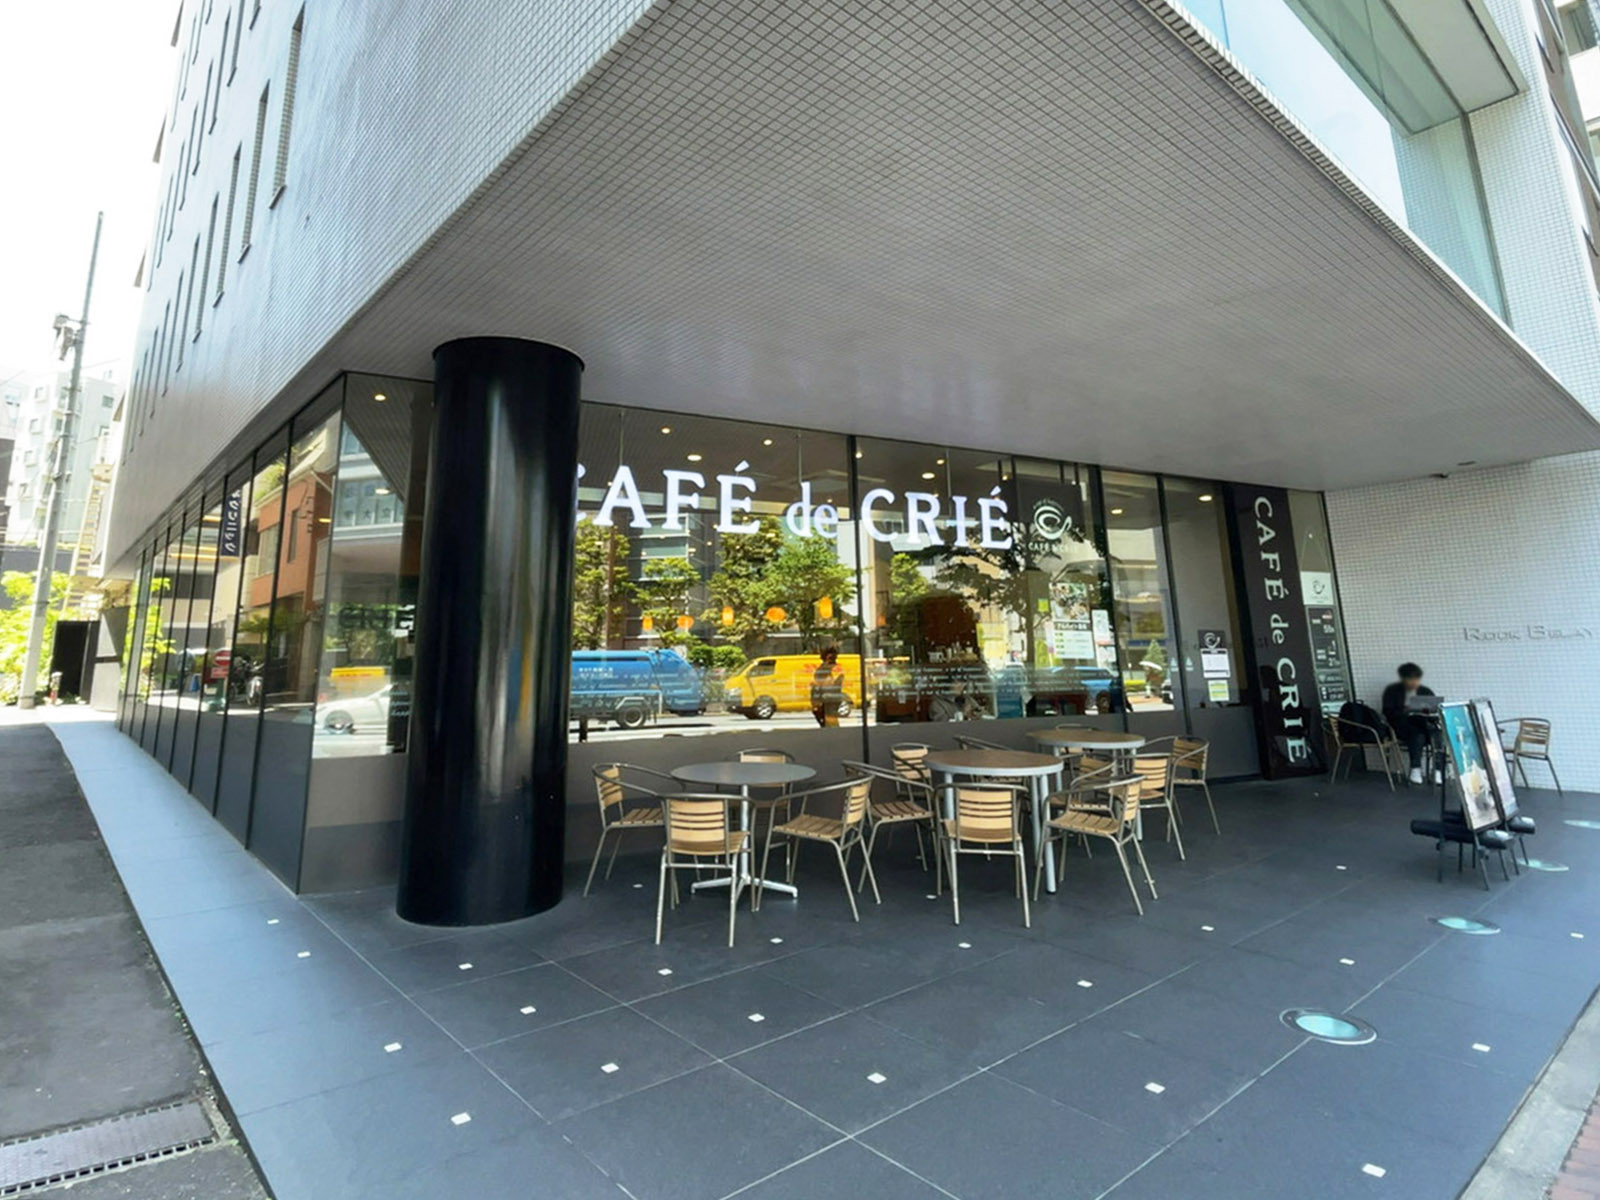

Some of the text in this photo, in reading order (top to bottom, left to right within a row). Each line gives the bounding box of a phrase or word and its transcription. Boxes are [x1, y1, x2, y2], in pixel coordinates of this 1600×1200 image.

[786, 481, 838, 539] de
[861, 485, 1013, 549] CRIÉ
[1254, 496, 1312, 763] CAFÉ de CRIÉ
